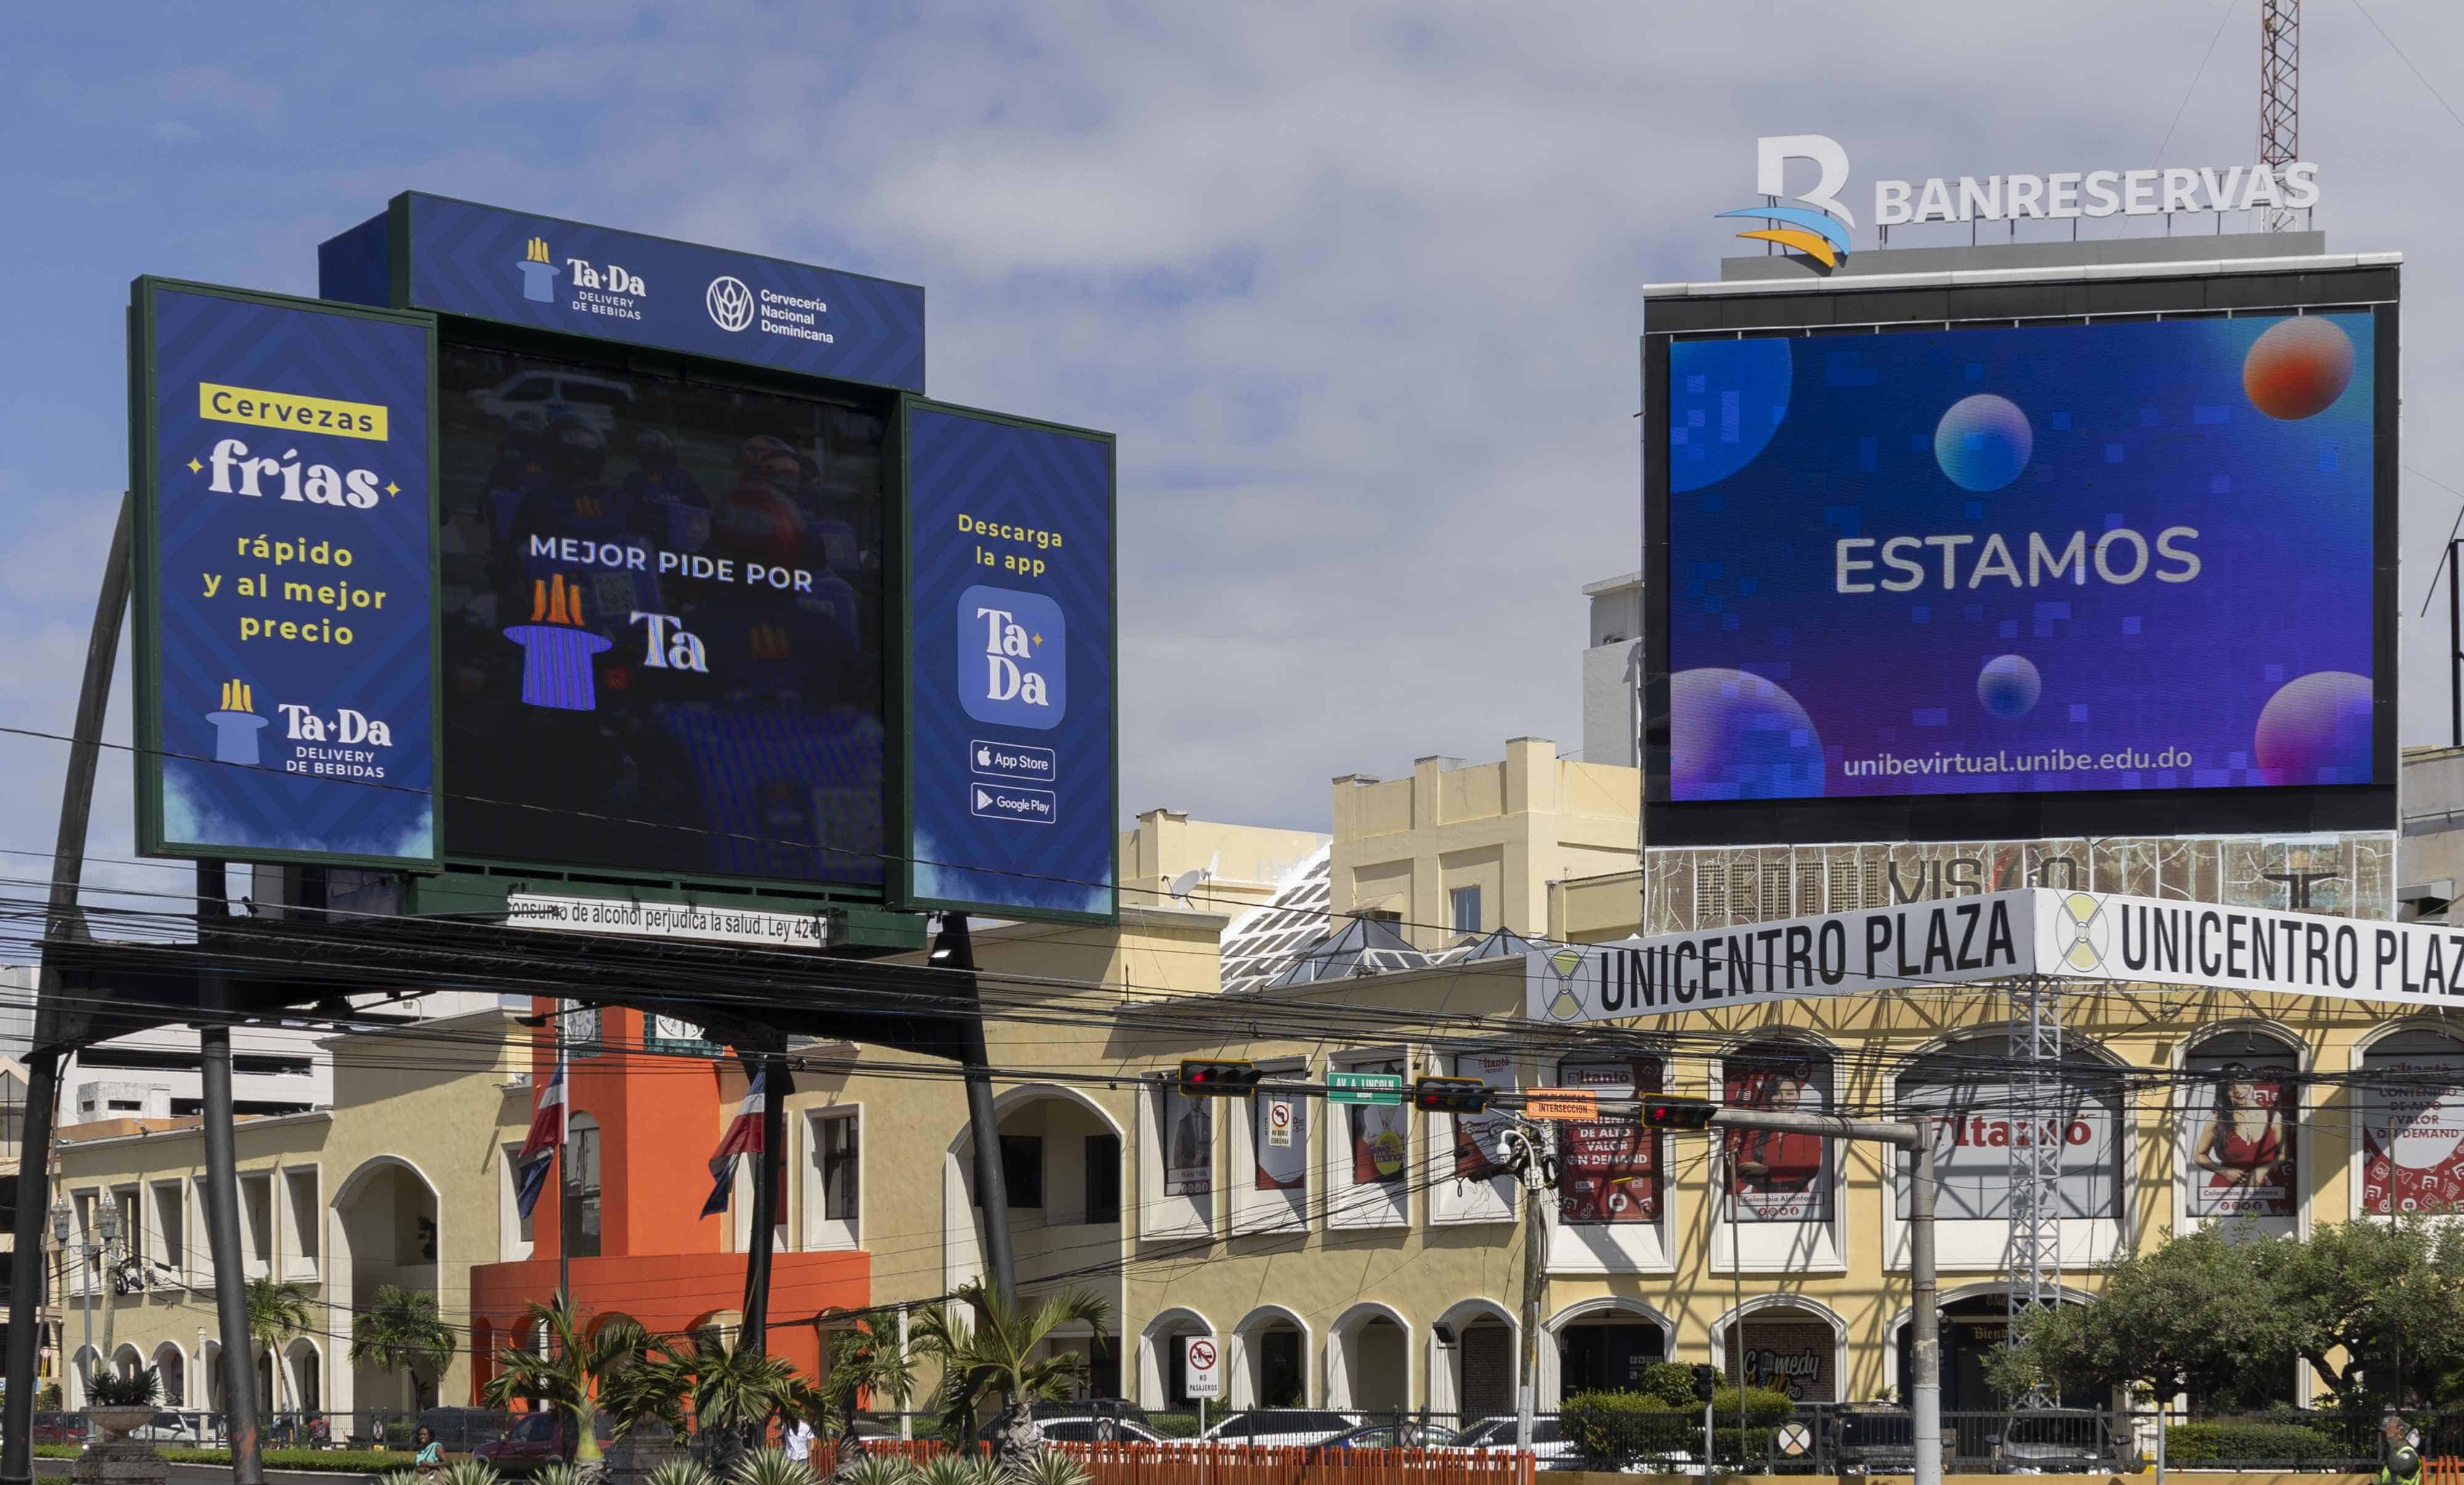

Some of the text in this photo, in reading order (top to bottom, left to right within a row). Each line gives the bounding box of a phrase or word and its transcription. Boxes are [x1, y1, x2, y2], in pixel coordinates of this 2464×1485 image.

[1875, 161, 2320, 227] BANRESERVAS
[572, 301, 641, 320] DE BEBIDAS
[579, 291, 634, 308] DELIVERY
[761, 289, 827, 312] Cervecería
[761, 304, 814, 325] Nacional
[761, 319, 833, 344] Dominicana
[211, 391, 374, 433] Cervezas
[208, 438, 379, 509] frías
[958, 514, 1063, 549] Descarga
[238, 534, 353, 567] rápido
[530, 534, 814, 593] MEJOR PIDE POR
[976, 545, 1045, 577] la app
[1835, 526, 2202, 595] ESTAMOS
[202, 573, 386, 612] y al mejor
[240, 615, 354, 645] precio
[630, 611, 709, 673] Ta
[976, 608, 1031, 659] Ta
[986, 654, 1049, 706] Da
[286, 759, 386, 779] DE BEBIDAS
[295, 746, 375, 763] DELIVERY
[994, 752, 1048, 770] App Store
[1844, 747, 2192, 777] unibevirtual.unibe.edu.do
[997, 795, 1050, 815] Google Play
[572, 901, 588, 922] de
[593, 902, 641, 926] alcohol
[646, 907, 707, 932] perjudica
[711, 910, 721, 932] la
[726, 913, 763, 935] salud.
[769, 915, 791, 942] Ley
[1602, 899, 2017, 1012] UNICENTRO PLAZA
[2122, 903, 2359, 989] UNICENTRO
[1538, 1103, 1588, 1114] INTERSECCION
[2396, 1114, 2439, 1125] VALOR
[1579, 1128, 1631, 1137] DE ALTO
[1586, 1141, 1627, 1151] VALOR
[2377, 1128, 2460, 1138] O DEMAND
[1592, 1155, 1648, 1165] DEMAND
